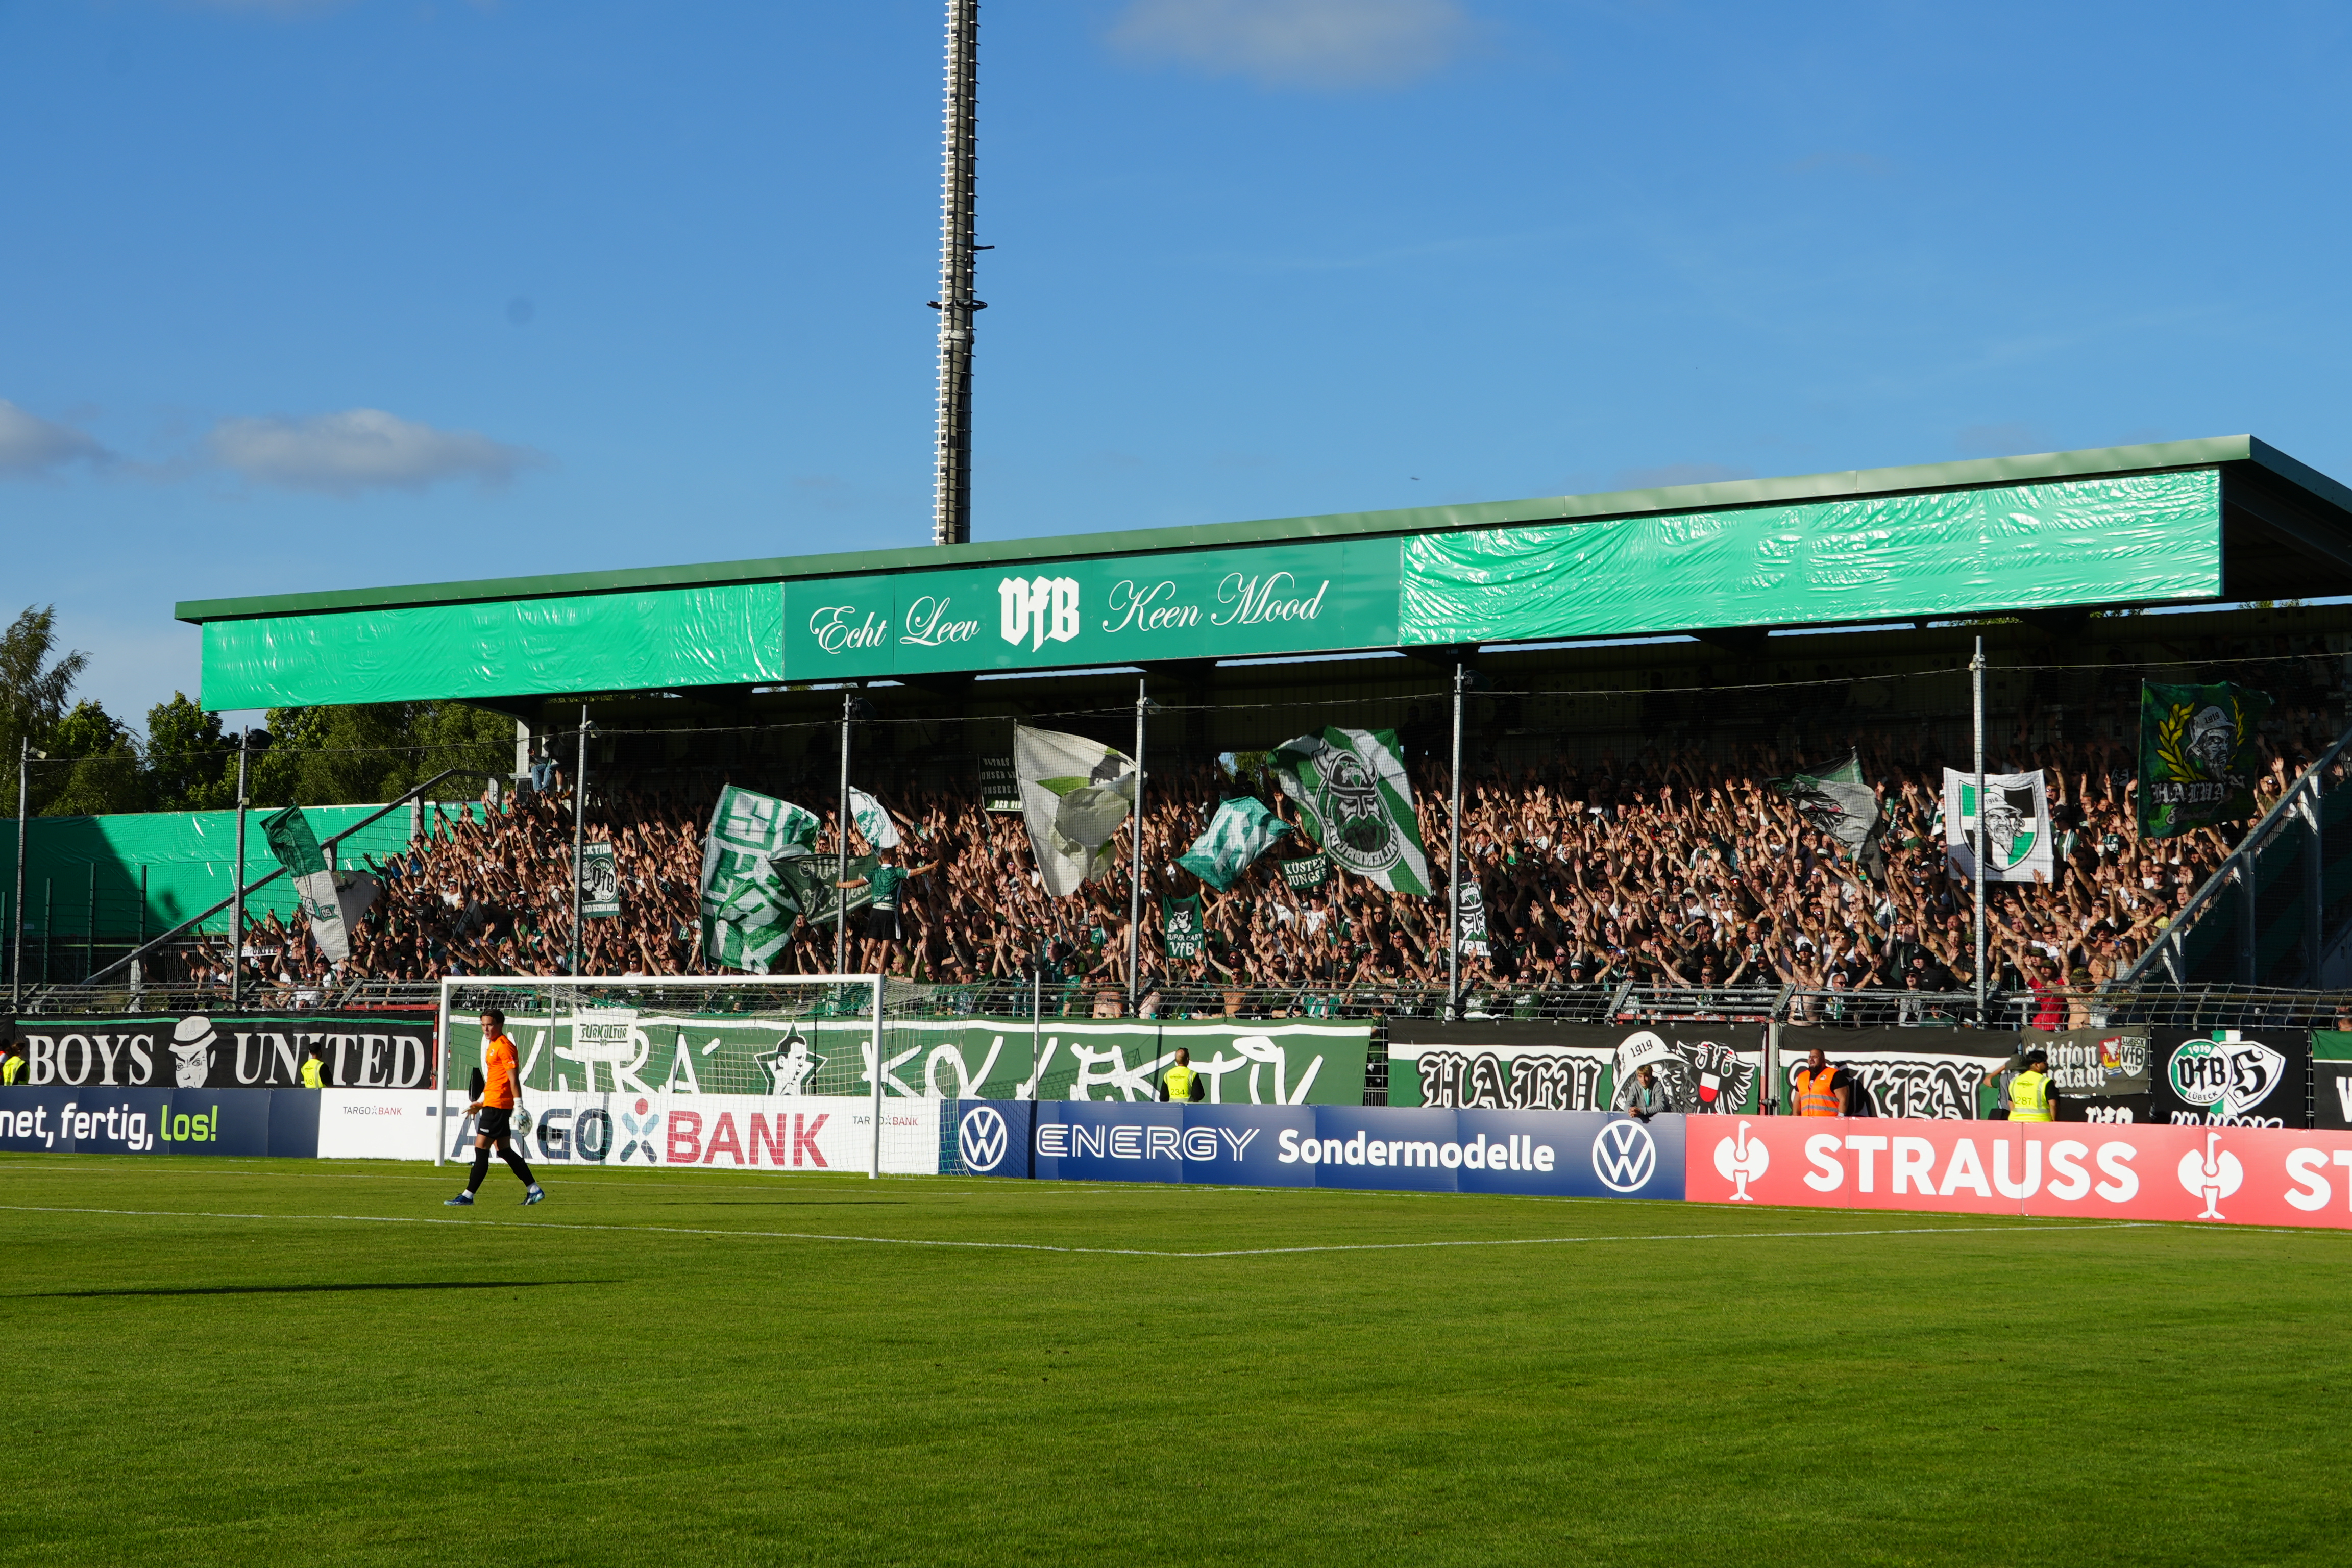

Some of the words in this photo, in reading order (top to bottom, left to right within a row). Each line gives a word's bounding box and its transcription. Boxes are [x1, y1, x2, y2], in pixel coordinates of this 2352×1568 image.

[810, 606, 887, 654] Echt
[900, 596, 980, 646] Leev
[998, 576, 1079, 652] VfB
[1102, 580, 1203, 632] Keen
[1211, 572, 1329, 625] Mood
[1287, 870, 1320, 886] JUNGS
[26, 1034, 153, 1085] BOYS
[235, 1033, 425, 1088] UNITED
[1630, 1039, 1653, 1057] 1919
[2121, 1046, 2144, 1066] VfB
[2188, 1044, 2211, 1055] 1919
[2177, 1056, 2226, 1092] VfB
[2016, 1096, 2032, 1106] 287
[2187, 1091, 2218, 1100] LÜBECK
[61, 1102, 153, 1150] fertig,
[161, 1105, 218, 1141] los!
[1036, 1124, 1260, 1162] ENERGY
[1278, 1129, 1555, 1171] Sondermodelle
[1803, 1134, 2139, 1203] STRAUSS
